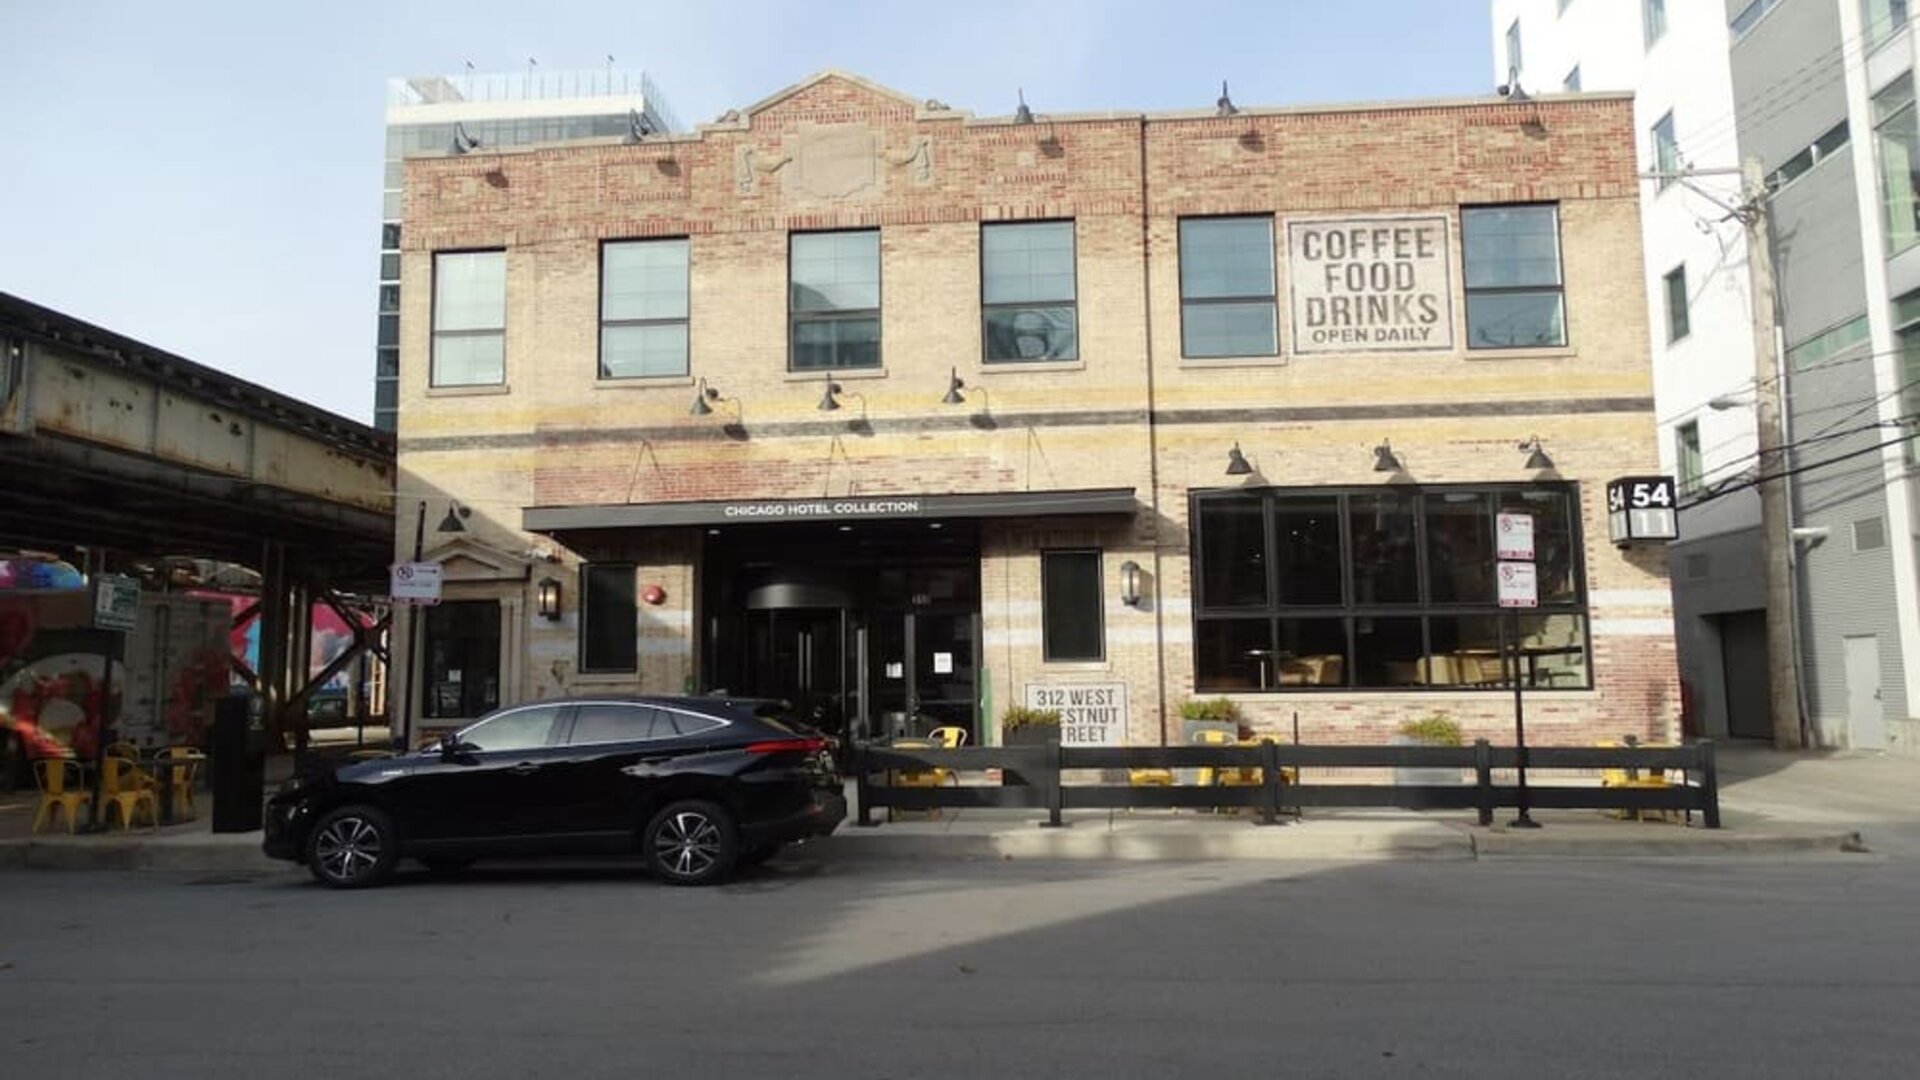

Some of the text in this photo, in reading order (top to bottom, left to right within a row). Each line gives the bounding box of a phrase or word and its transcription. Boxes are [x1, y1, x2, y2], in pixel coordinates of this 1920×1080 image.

[1303, 228, 1435, 261] COFFEE
[1325, 261, 1415, 293] FOOD
[1306, 294, 1438, 327] DRINKS
[1312, 327, 1431, 343] OPEN DAILY
[1632, 483, 1671, 507] 54
[724, 501, 918, 516] CHICAGO HOTEL COLLECTION
[1036, 689, 1114, 706] 312 WEST
[1059, 726, 1106, 742] REET
